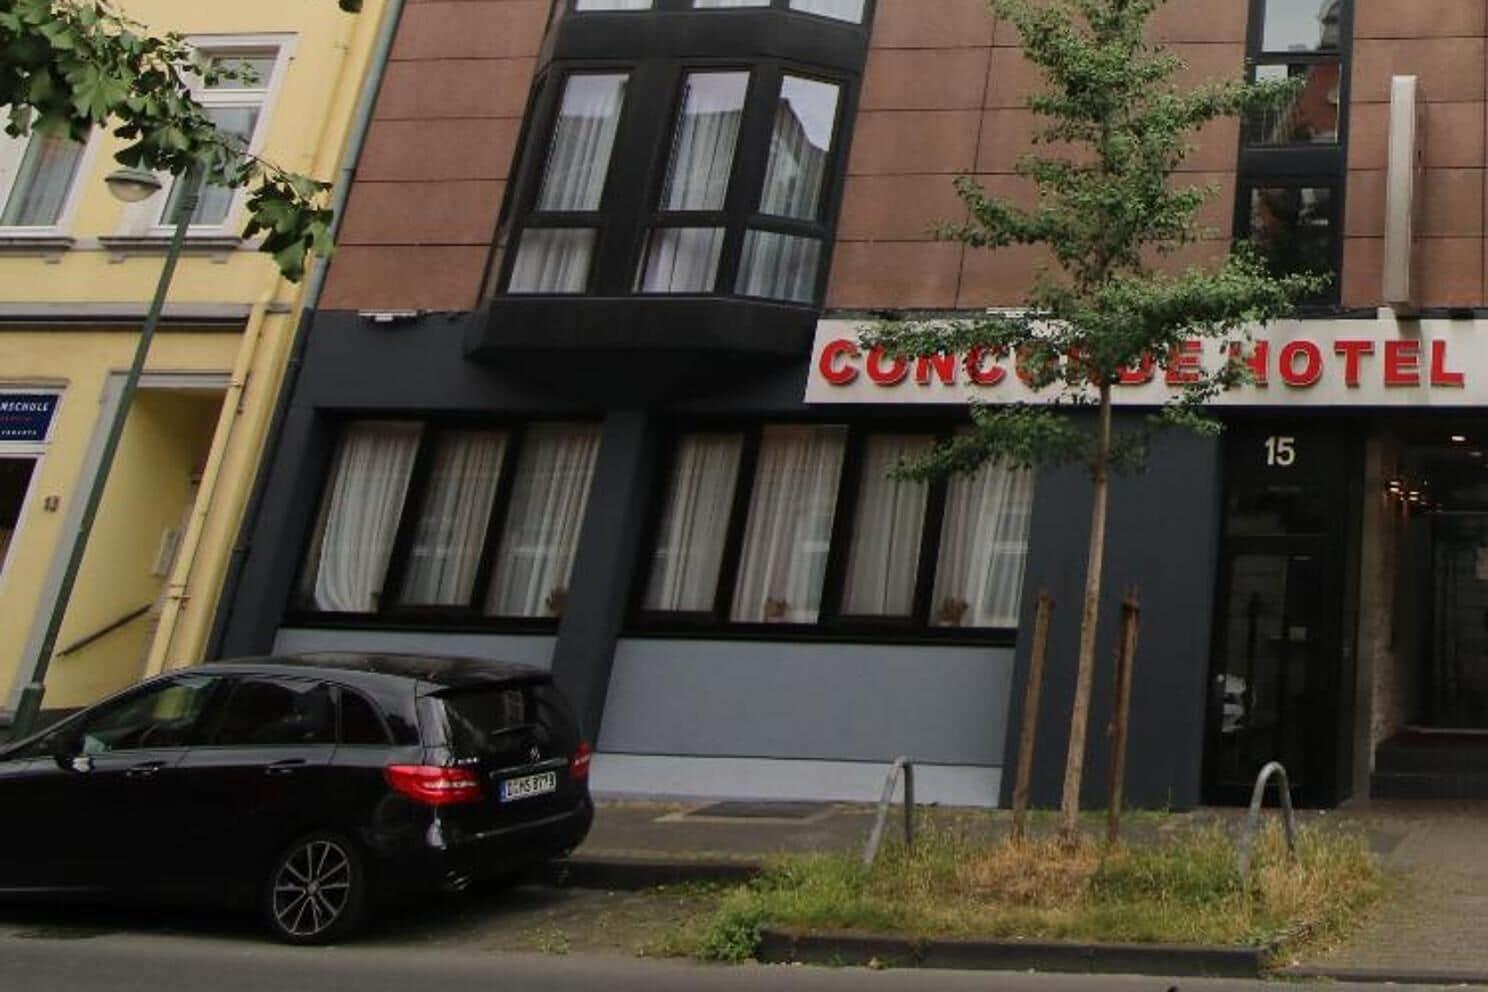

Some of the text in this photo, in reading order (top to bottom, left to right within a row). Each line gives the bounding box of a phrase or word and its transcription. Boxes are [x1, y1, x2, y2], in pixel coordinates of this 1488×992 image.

[819, 337, 1202, 386] CONCODE
[1226, 338, 1465, 388] HOTEL
[1264, 435, 1296, 467] 15
